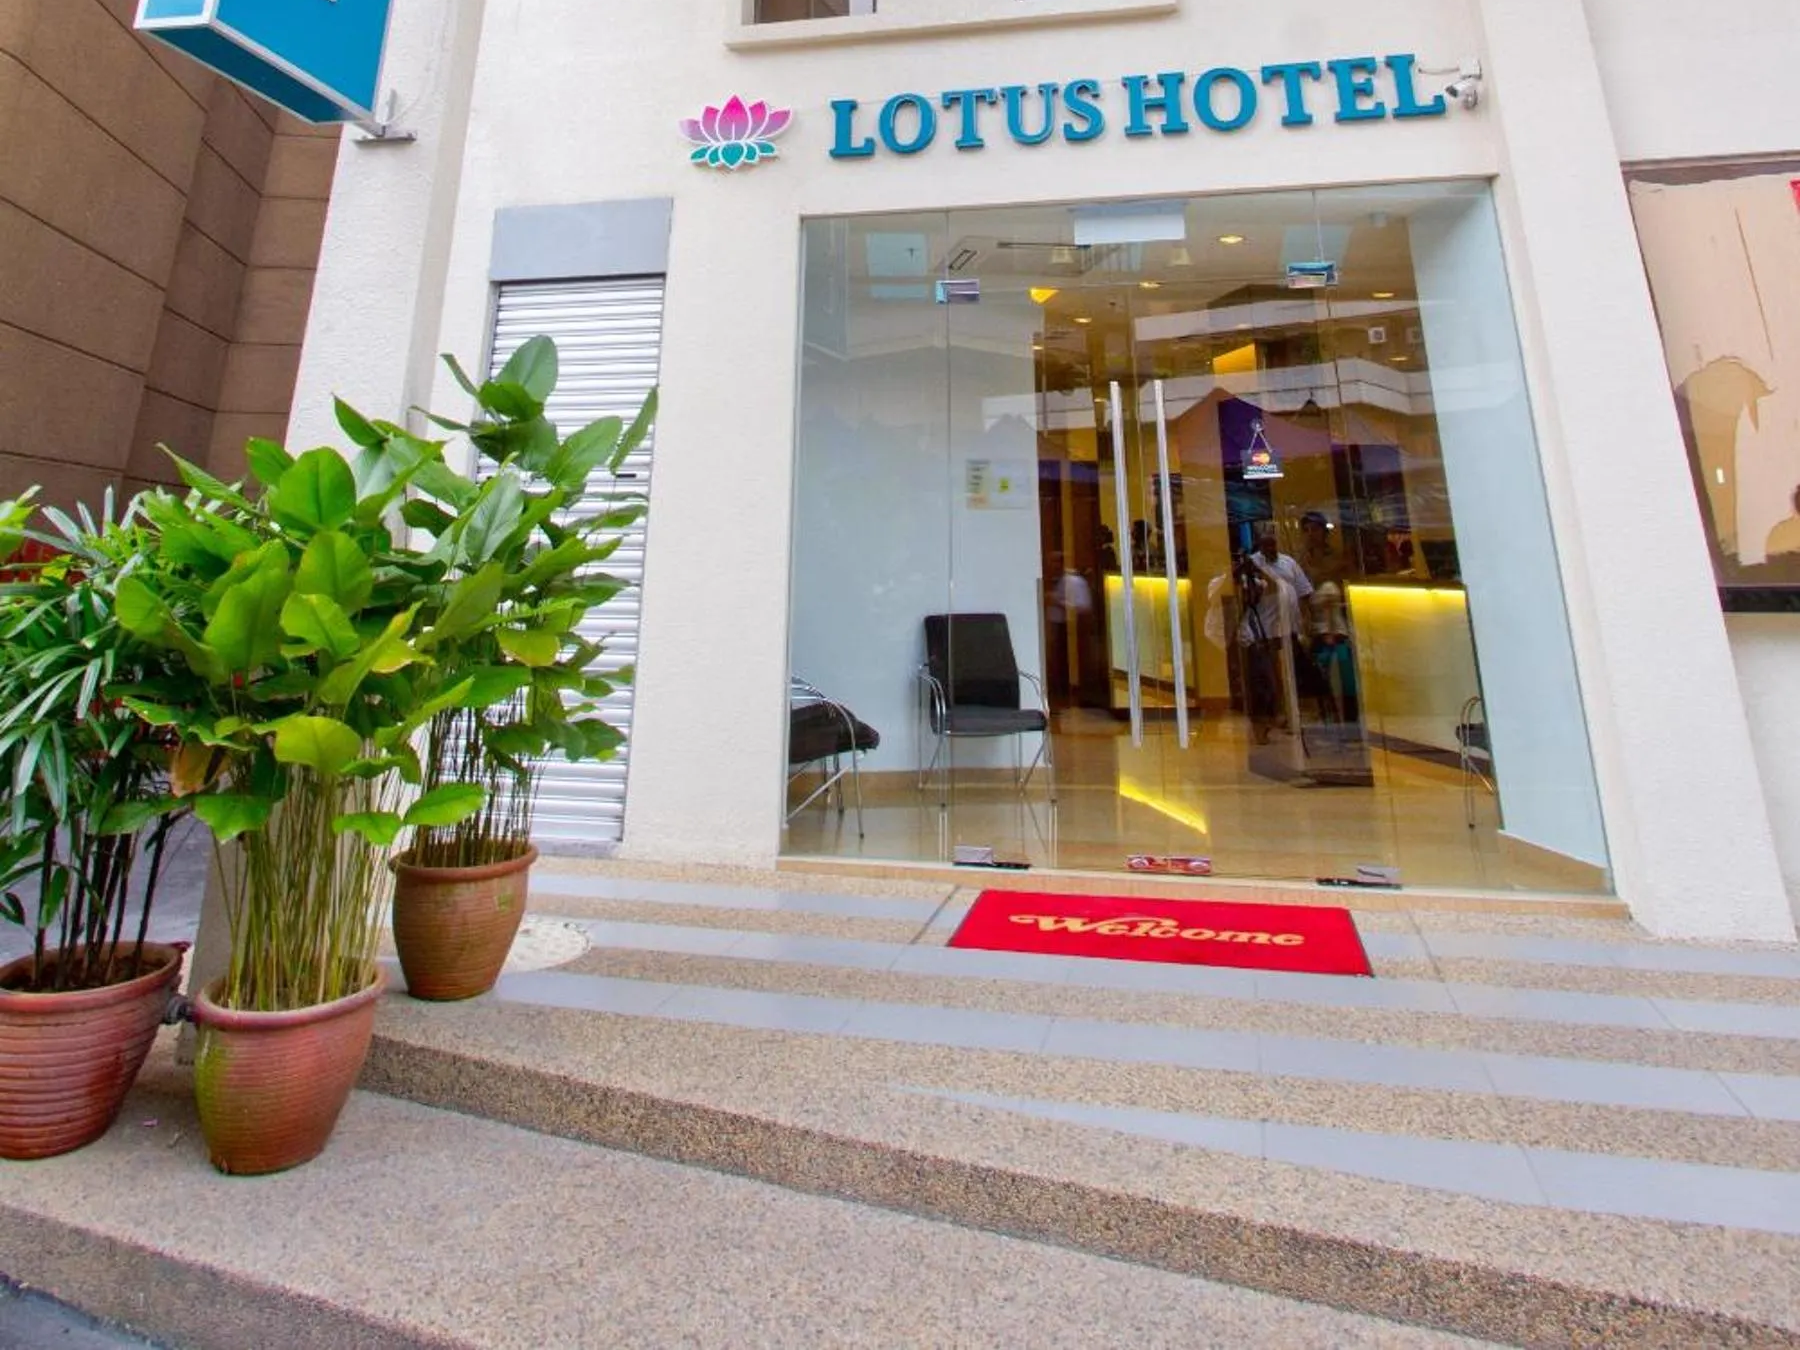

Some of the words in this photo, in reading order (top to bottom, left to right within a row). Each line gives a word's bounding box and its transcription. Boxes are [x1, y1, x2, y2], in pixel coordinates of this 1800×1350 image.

[829, 79, 1106, 158] LOTUS
[1122, 54, 1447, 137] HOTEL
[1009, 914, 1305, 946] Welcome
